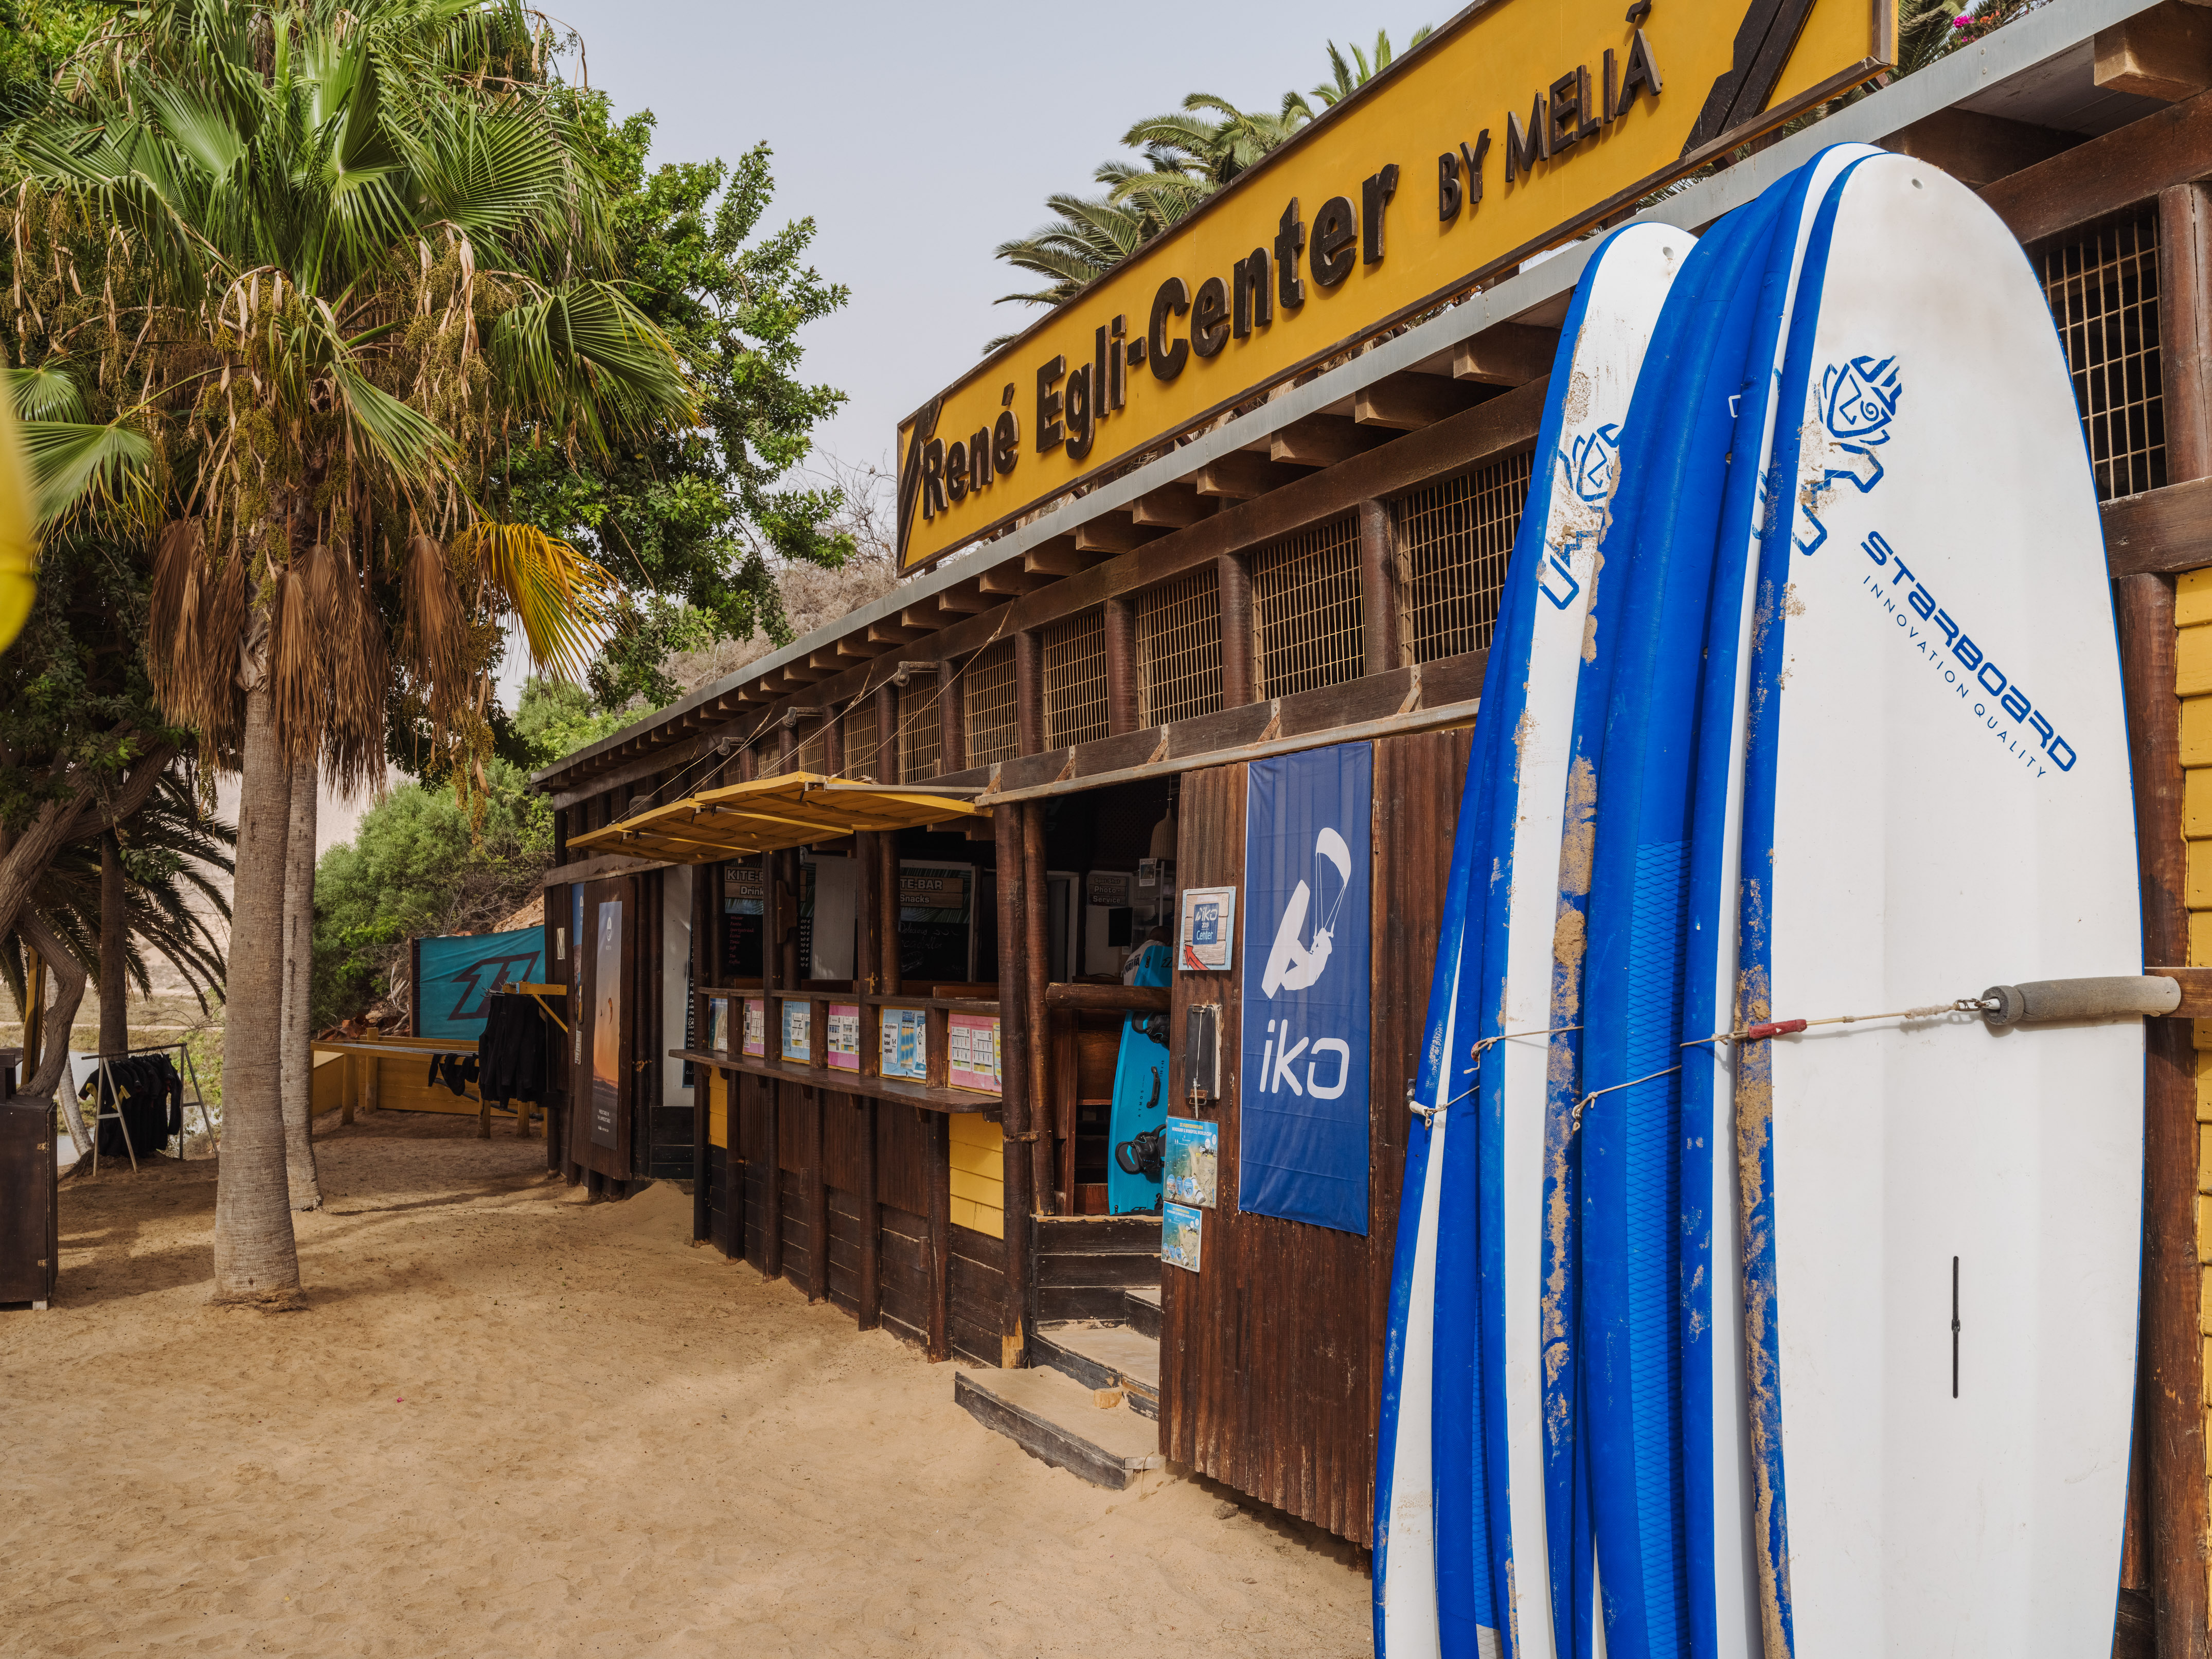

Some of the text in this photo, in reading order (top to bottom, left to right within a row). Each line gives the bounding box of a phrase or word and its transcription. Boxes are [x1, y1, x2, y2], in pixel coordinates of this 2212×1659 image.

[922, 382, 1019, 520] René
[1036, 163, 1399, 460] Egli-Center
[1438, 128, 1491, 222] BY
[1863, 575, 2048, 779] INNOVATION QUALITY
[900, 893, 930, 903] Snacks
[1201, 907, 1218, 921] iko
[1197, 930, 1214, 940] Center
[1259, 1019, 1349, 1100] iko
